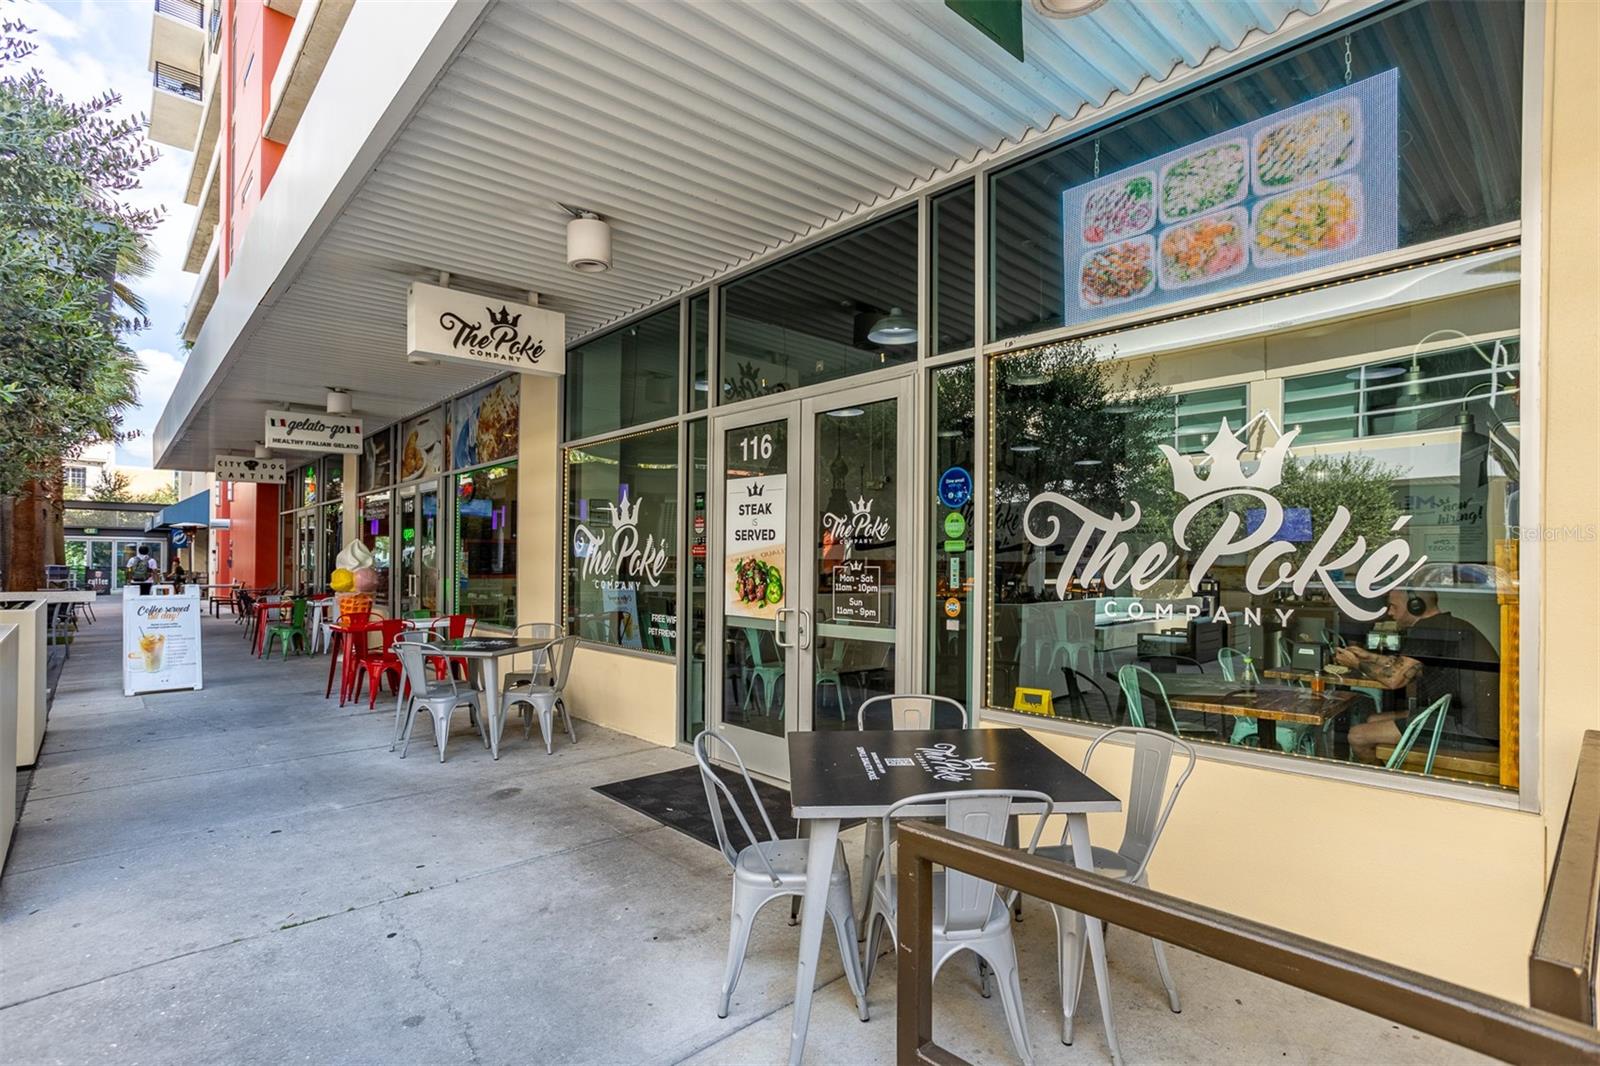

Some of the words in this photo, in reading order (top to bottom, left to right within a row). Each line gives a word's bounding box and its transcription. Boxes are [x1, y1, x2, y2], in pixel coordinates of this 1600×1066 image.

[440, 312, 492, 349] The
[490, 325, 546, 363] Poké
[469, 348, 521, 362] COMPANY
[286, 418, 345, 439] gelato-go
[272, 437, 304, 445] HEALTHY
[333, 442, 359, 450] GELATO
[740, 433, 773, 461] 116
[217, 471, 285, 481] CANTINA
[738, 502, 773, 516] STEAK
[823, 512, 854, 543] The
[852, 512, 891, 541] Poké
[734, 529, 776, 541] SERVED
[573, 524, 615, 581] The
[612, 524, 668, 588] Poké
[1022, 491, 1180, 601] The
[1173, 488, 1429, 622] Poké
[840, 574, 855, 582] Mon
[860, 573, 874, 582] Sat
[594, 579, 641, 591] COMPANY
[835, 583, 853, 591] 11am
[858, 584, 878, 593] 10pm
[849, 597, 863, 606] Sun
[137, 605, 162, 616] Coffee
[836, 606, 854, 615] 11am
[860, 607, 876, 617] 9pm
[1104, 601, 1296, 628] COMPANY
[651, 614, 666, 623] FREE
[648, 627, 658, 636] PET
[916, 742, 959, 760] The
